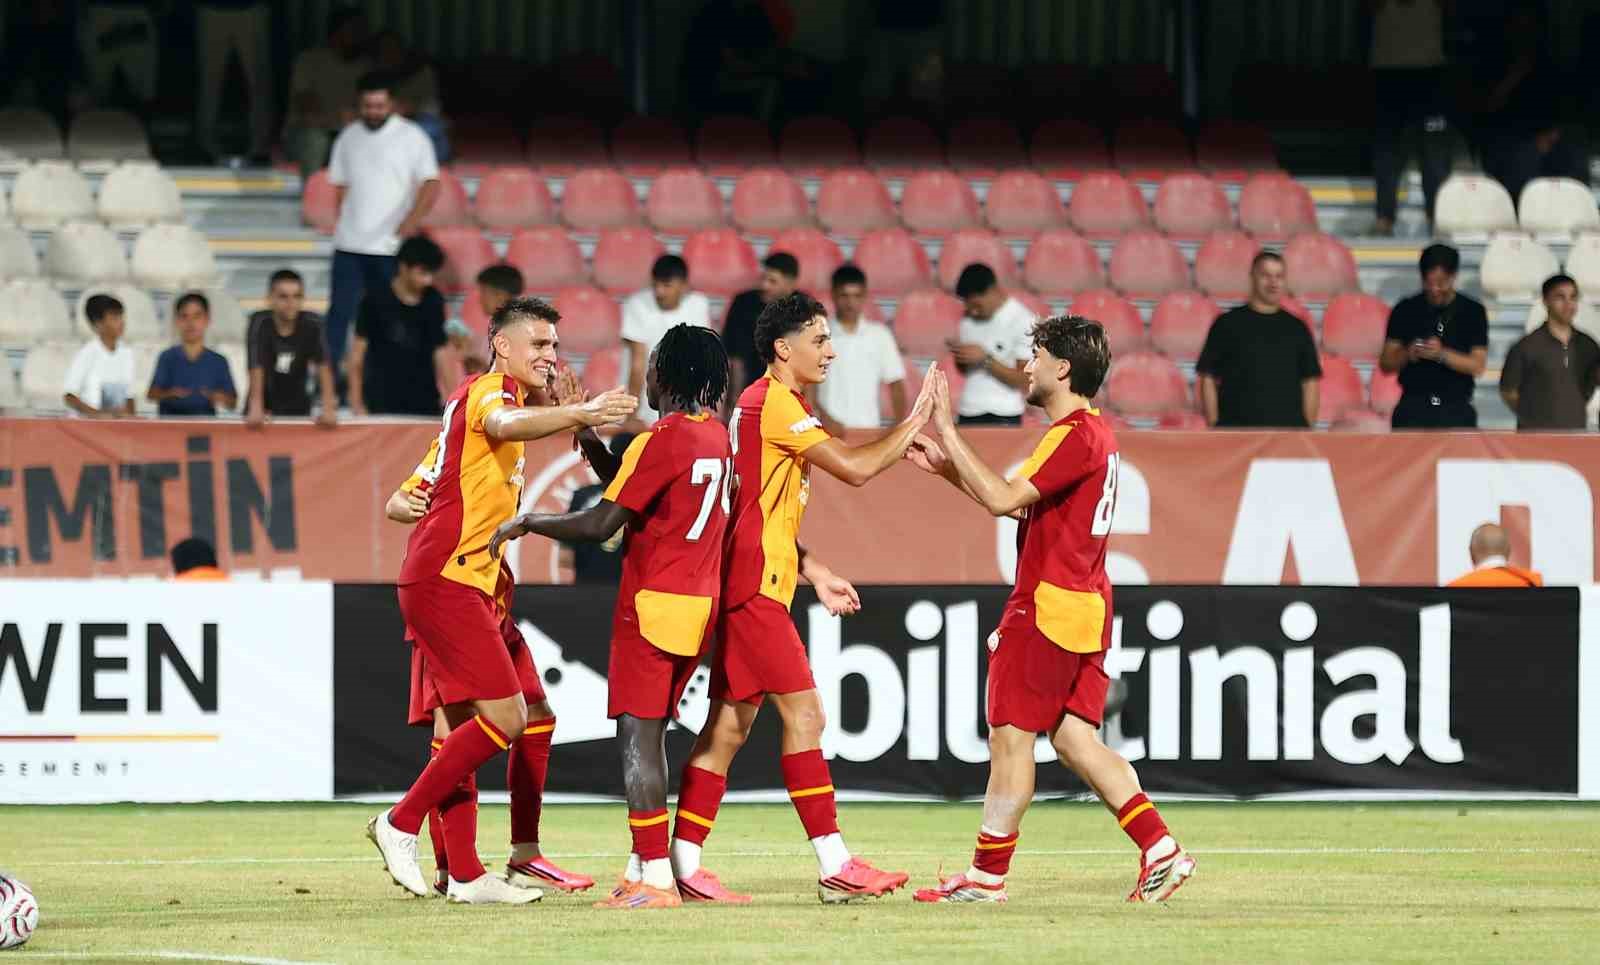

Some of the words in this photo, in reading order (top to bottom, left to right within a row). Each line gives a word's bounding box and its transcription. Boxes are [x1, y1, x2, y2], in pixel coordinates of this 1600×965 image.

[686, 458, 731, 541] 7
[1091, 452, 1120, 535] 8
[808, 600, 1464, 766] biltinial
